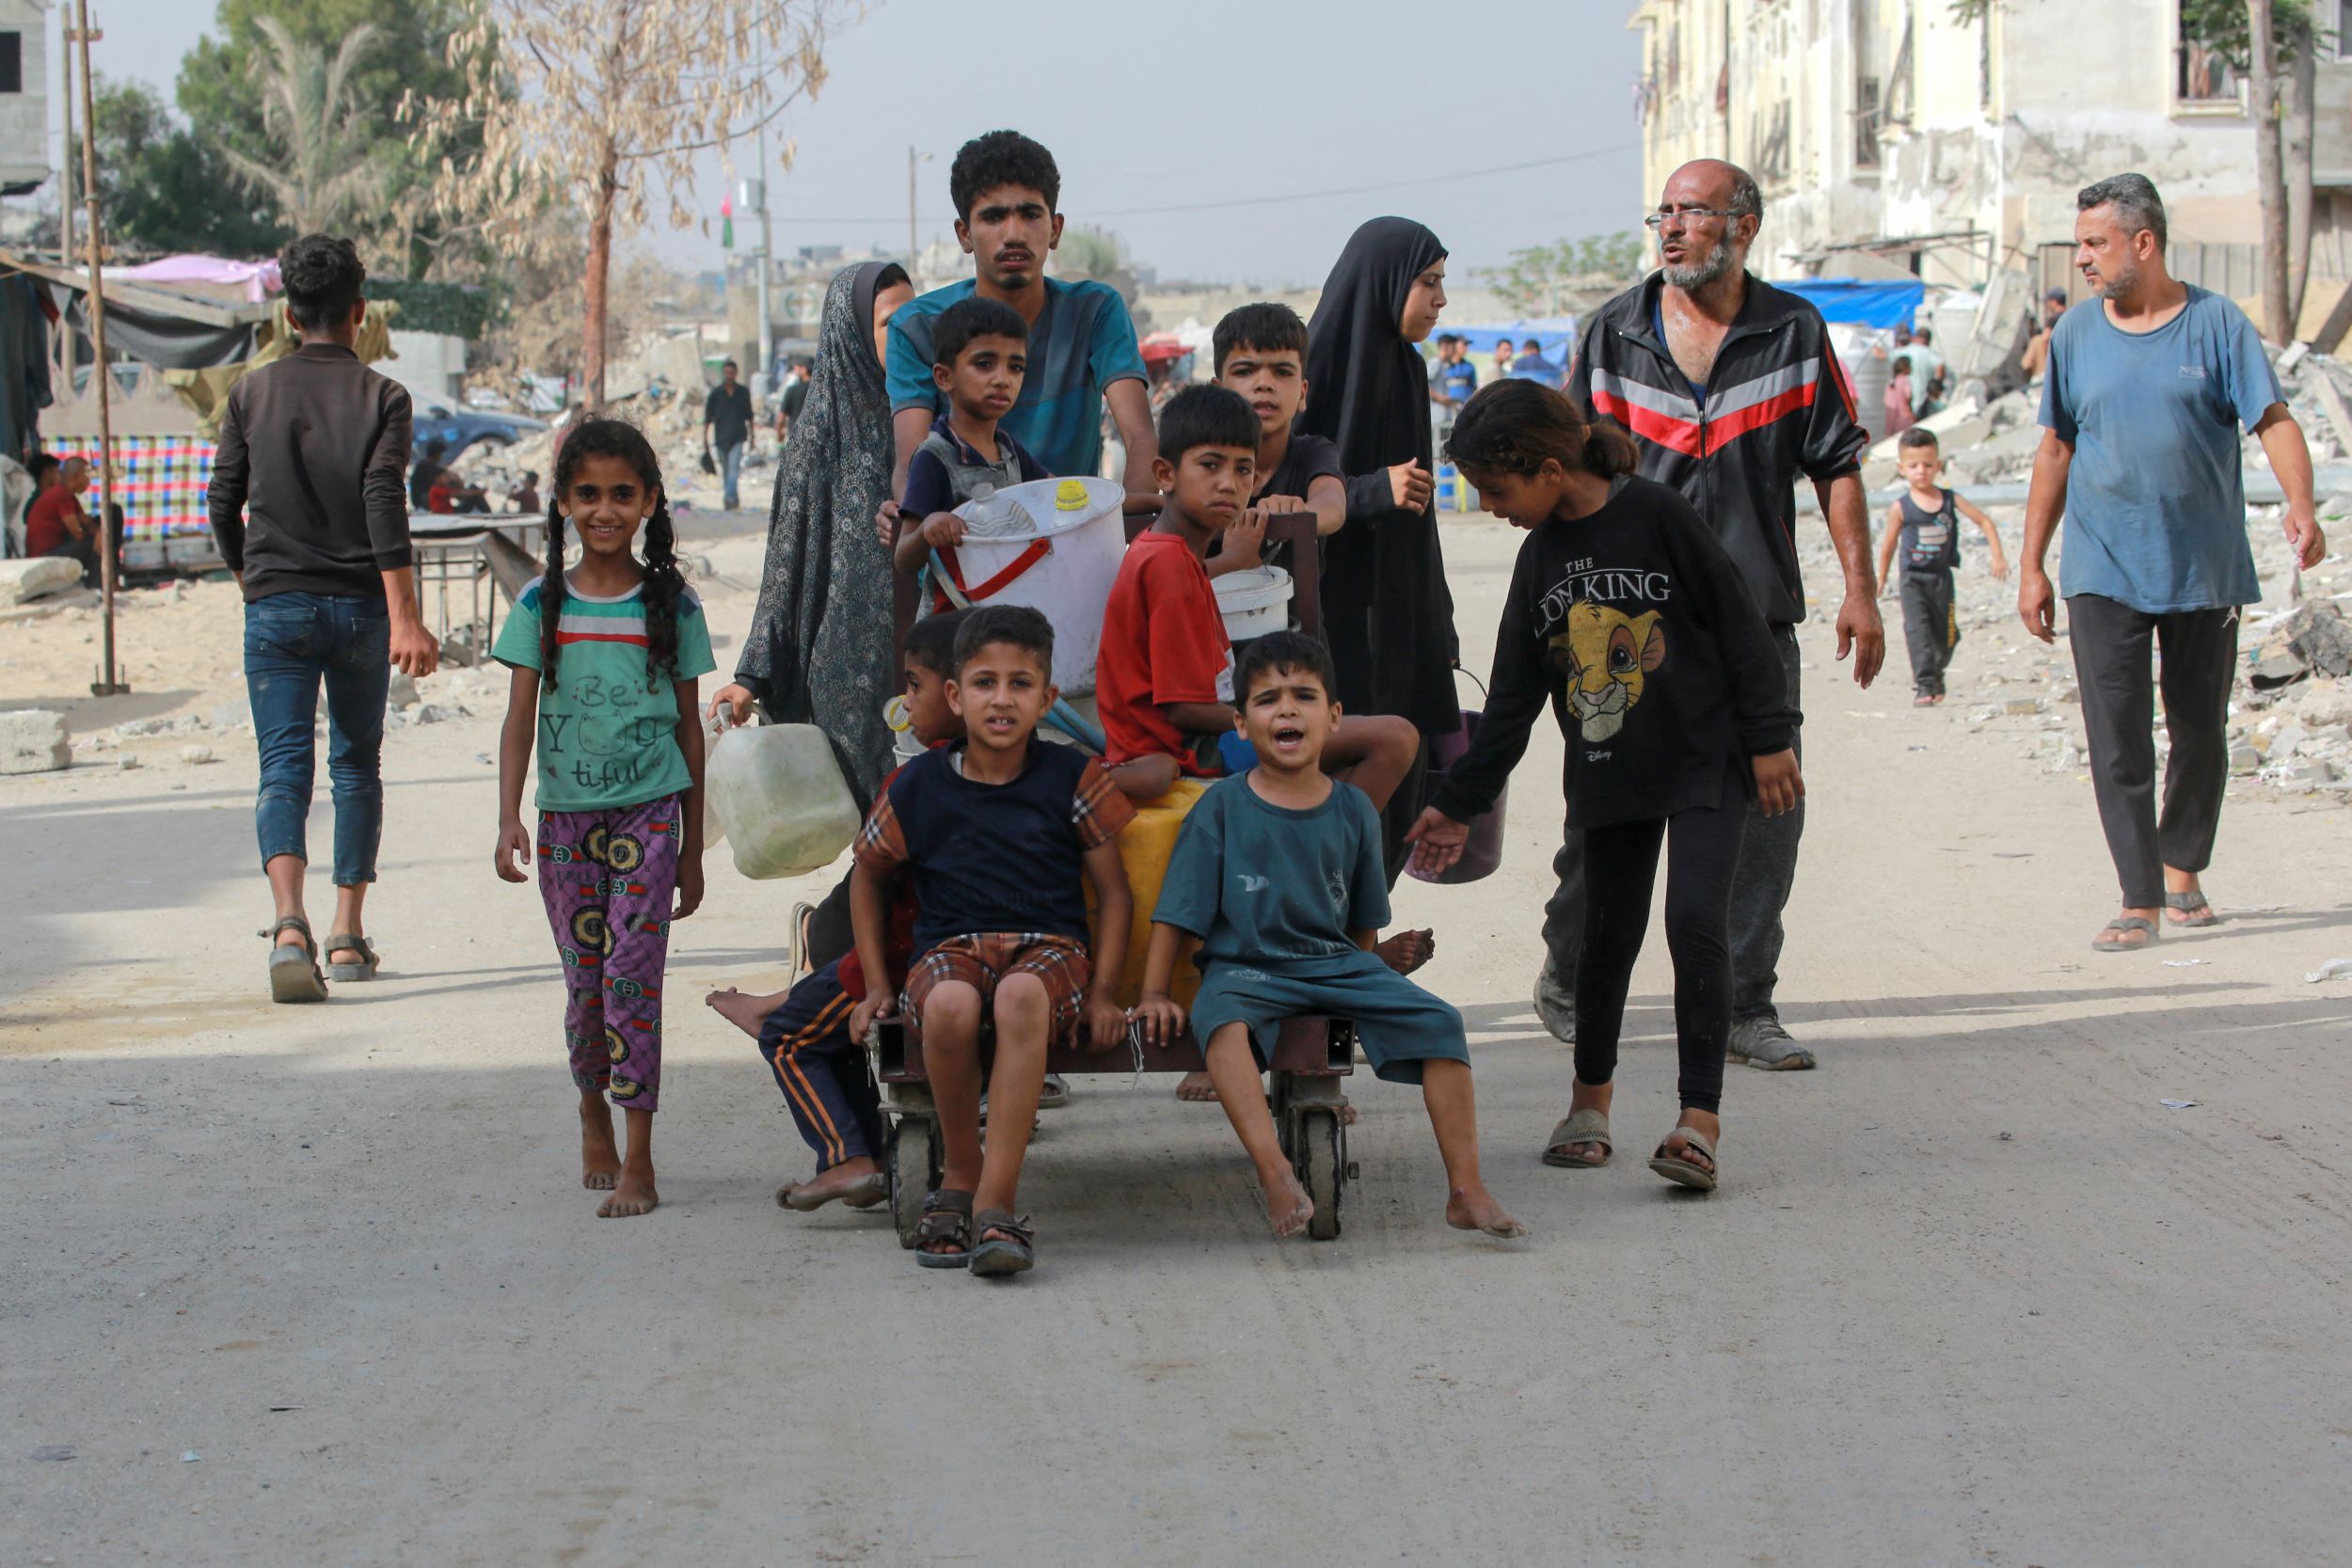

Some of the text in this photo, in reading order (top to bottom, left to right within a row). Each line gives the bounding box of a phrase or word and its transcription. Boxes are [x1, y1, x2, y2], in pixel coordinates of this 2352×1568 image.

[1565, 557, 1594, 574] THE
[1581, 572, 1671, 601] KING
[576, 674, 634, 707] Be
[570, 757, 646, 792] tiful
